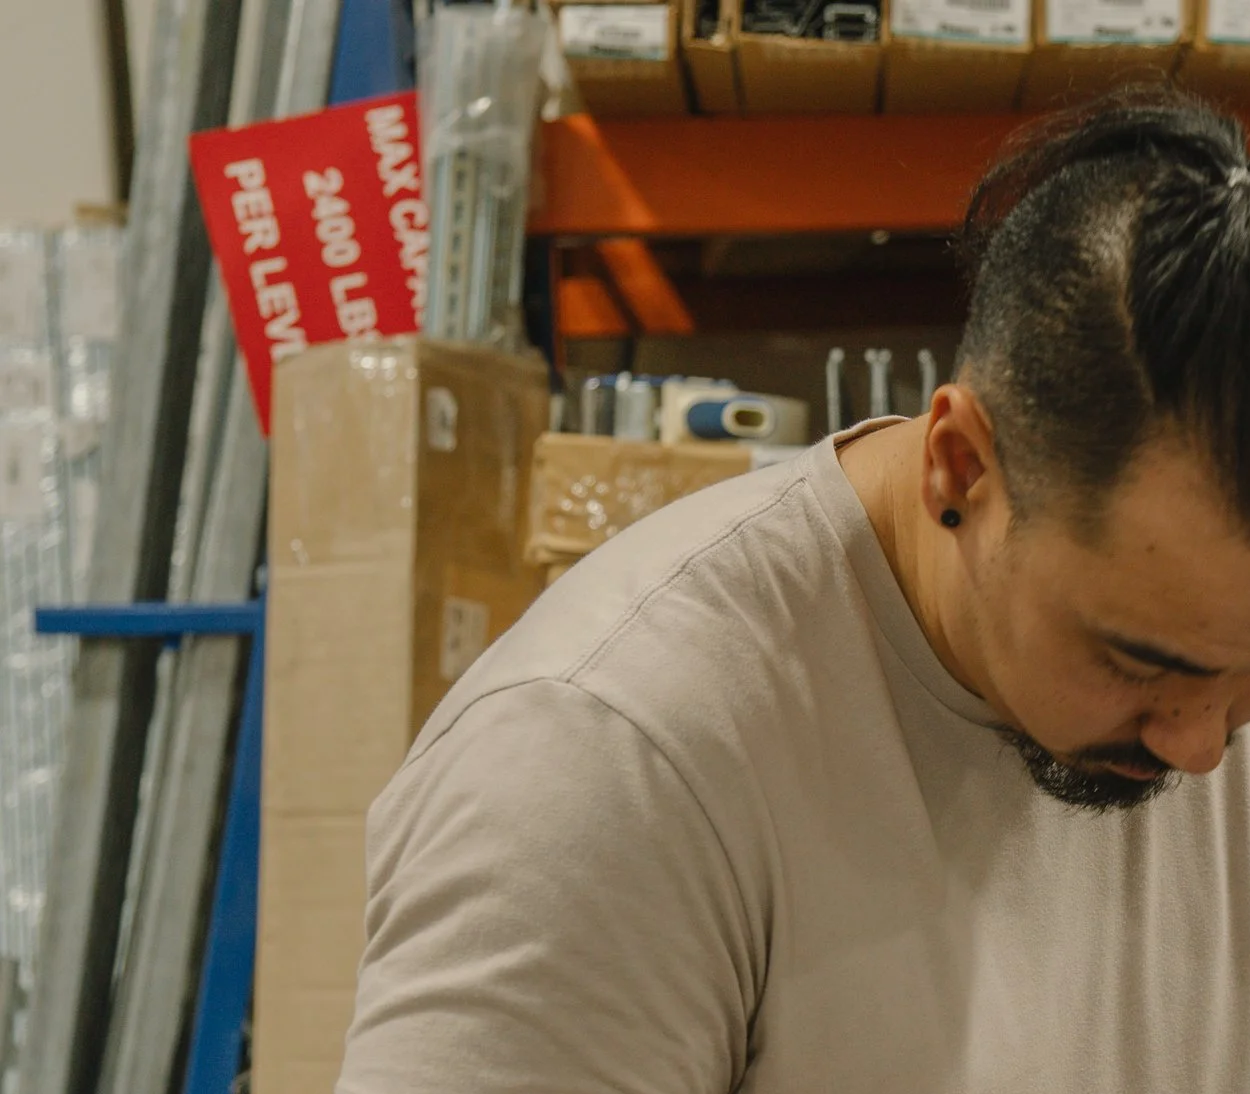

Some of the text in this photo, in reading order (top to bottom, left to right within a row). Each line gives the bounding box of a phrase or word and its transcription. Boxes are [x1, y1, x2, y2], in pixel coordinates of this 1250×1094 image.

[364, 104, 421, 197] MAX
[223, 157, 281, 255] PER
[302, 166, 361, 268] 2400
